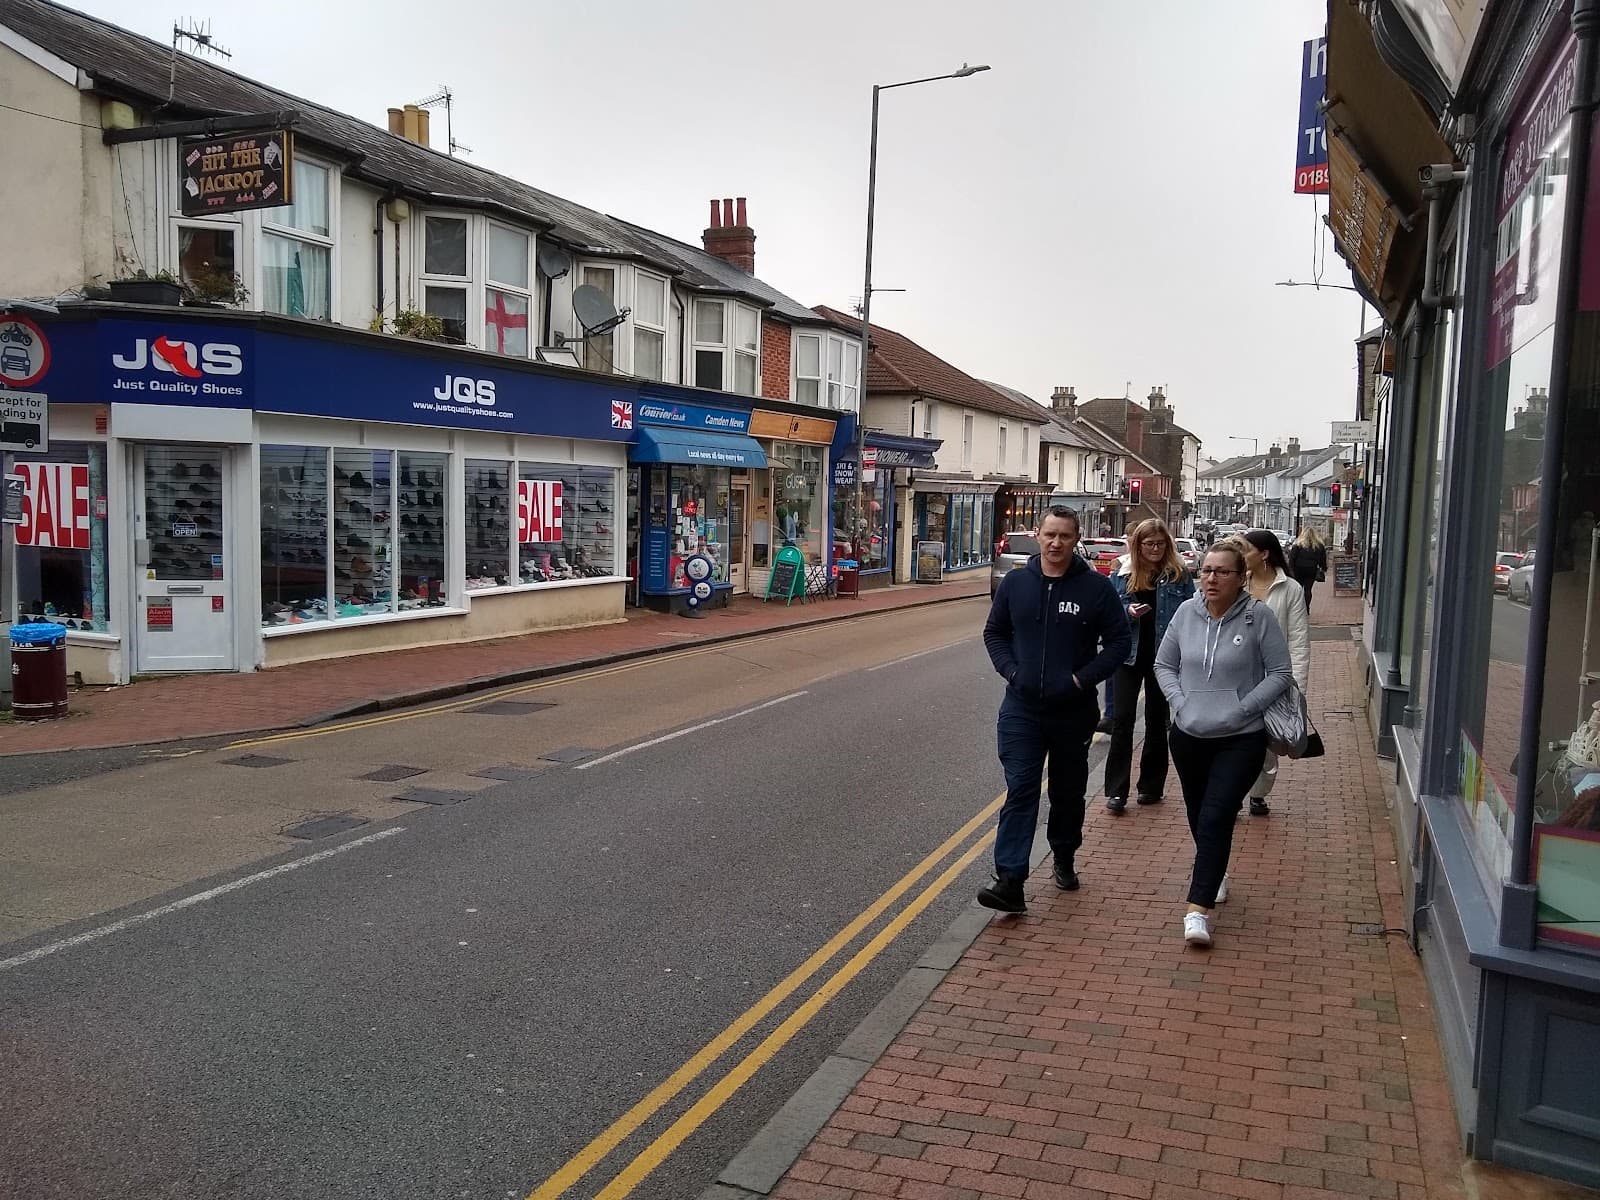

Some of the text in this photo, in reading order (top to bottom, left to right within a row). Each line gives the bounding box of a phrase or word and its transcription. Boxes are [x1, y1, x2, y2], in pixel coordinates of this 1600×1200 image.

[202, 152, 228, 172] HIT
[231, 147, 261, 169] THE
[1502, 140, 1525, 210] ROSE
[199, 170, 264, 200] JACKPOT
[112, 379, 243, 395] Just Quality Shoes
[434, 374, 496, 406] JQS
[26, 397, 41, 407] for
[412, 401, 514, 419] www.justqualityshoes.com
[29, 410, 42, 421] by
[705, 414, 745, 429] Camden News
[687, 449, 700, 458] Local
[836, 462, 853, 470] SKI &
[834, 477, 854, 485] WEAR
[14, 464, 90, 548] SALE
[519, 481, 562, 542] SALE
[1058, 601, 1080, 615] GAP
